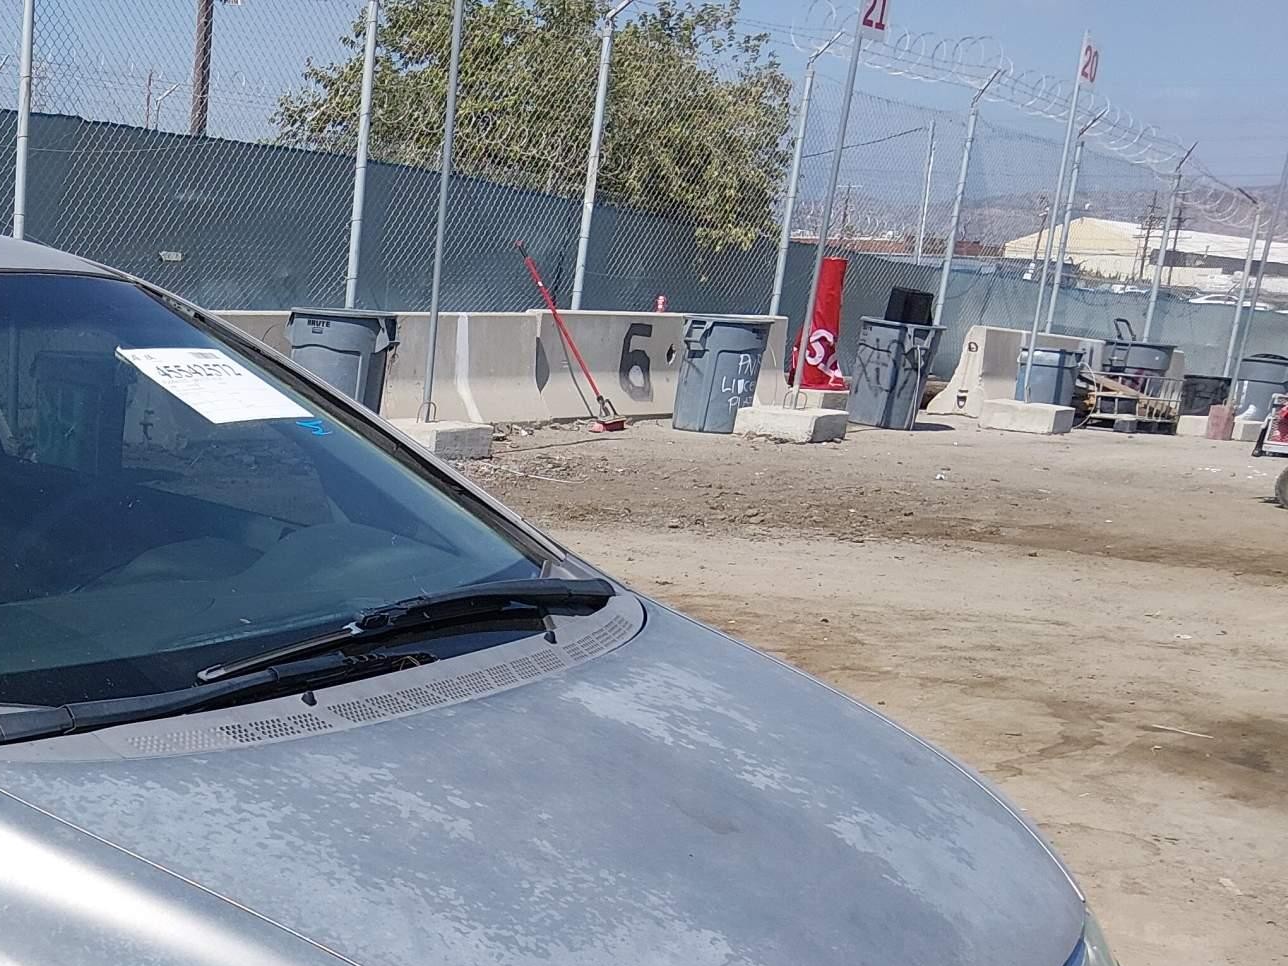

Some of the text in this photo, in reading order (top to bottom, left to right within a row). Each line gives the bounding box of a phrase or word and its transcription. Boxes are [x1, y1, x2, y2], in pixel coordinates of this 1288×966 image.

[862, 0, 887, 31] 21
[1080, 44, 1099, 84] 20
[307, 319, 331, 328] BRUTE
[155, 363, 242, 380] 45542572
[619, 323, 653, 401] 6
